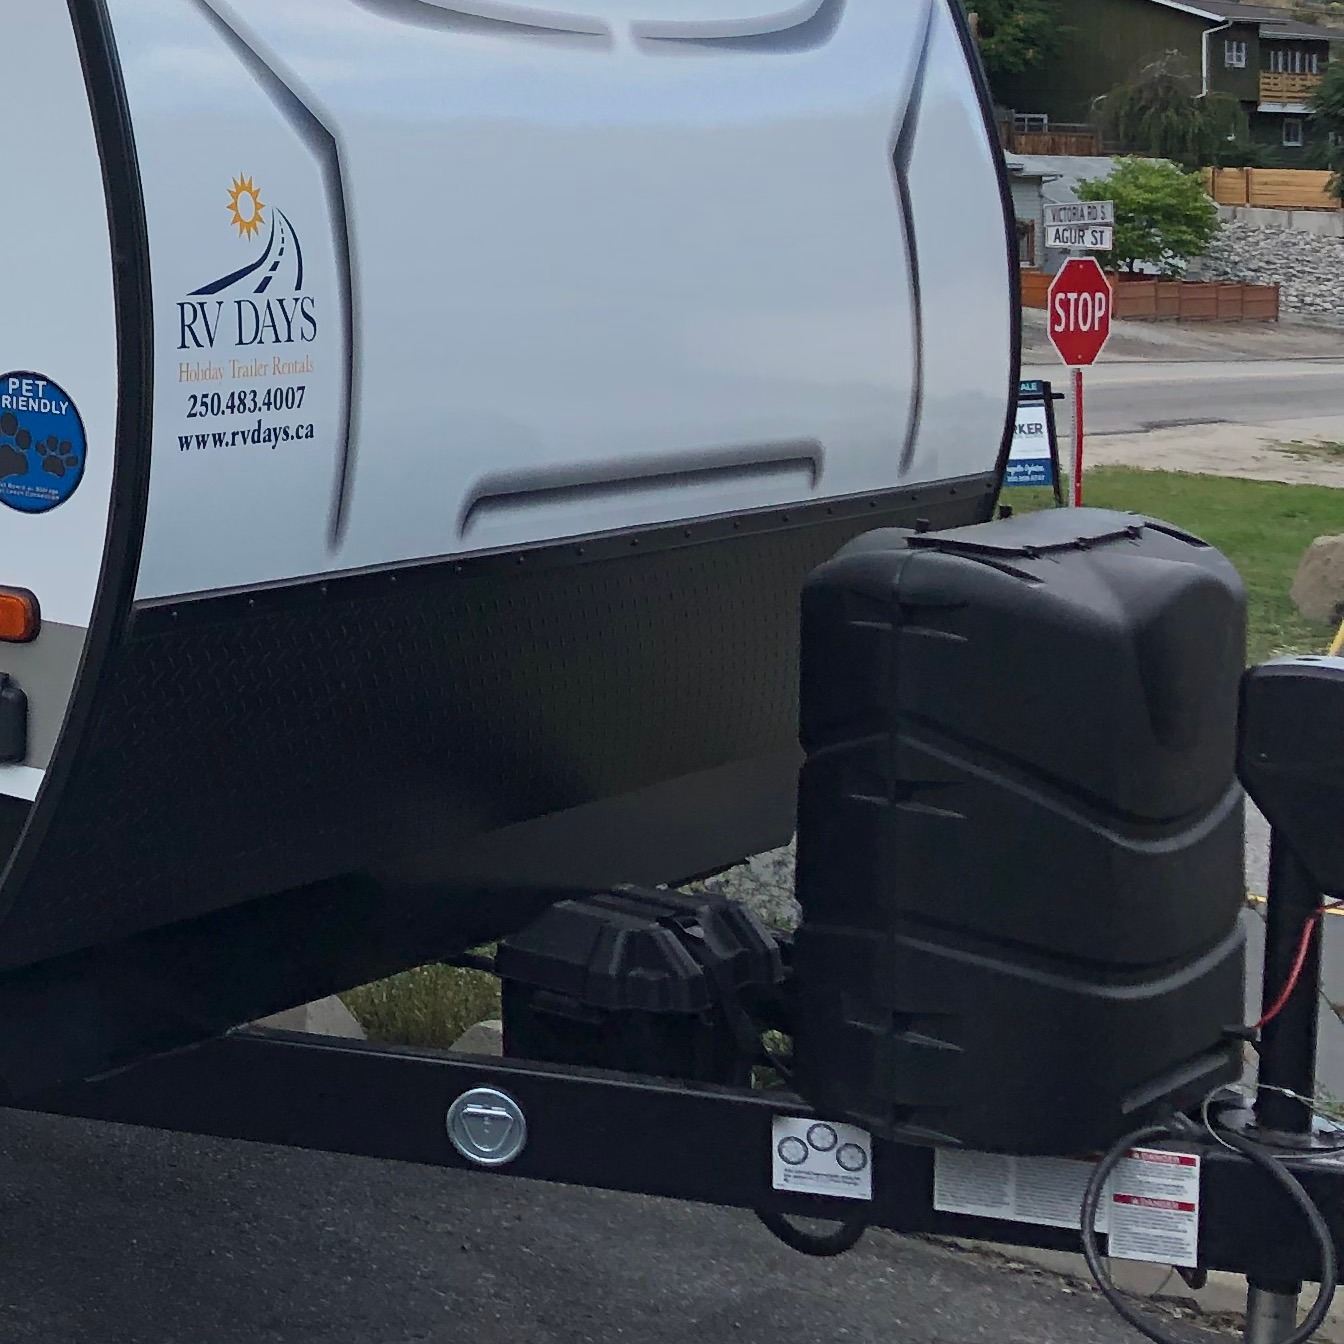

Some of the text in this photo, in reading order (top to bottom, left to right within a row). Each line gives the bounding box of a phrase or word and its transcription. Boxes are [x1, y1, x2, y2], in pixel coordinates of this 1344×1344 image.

[1051, 206, 1086, 223] VICTORIA
[1087, 205, 1098, 221] RD
[1053, 227, 1105, 246] AGUR ST
[176, 296, 317, 349] RV DAYS
[1054, 292, 1106, 332] STOP
[178, 354, 314, 385] Holiday Trailer Rentals
[8, 377, 47, 398] PET
[1020, 382, 1038, 391] ALE
[186, 386, 306, 419] 250.483.4007
[177, 418, 315, 452] www.rvdays.ca
[1012, 422, 1044, 436] RKER
